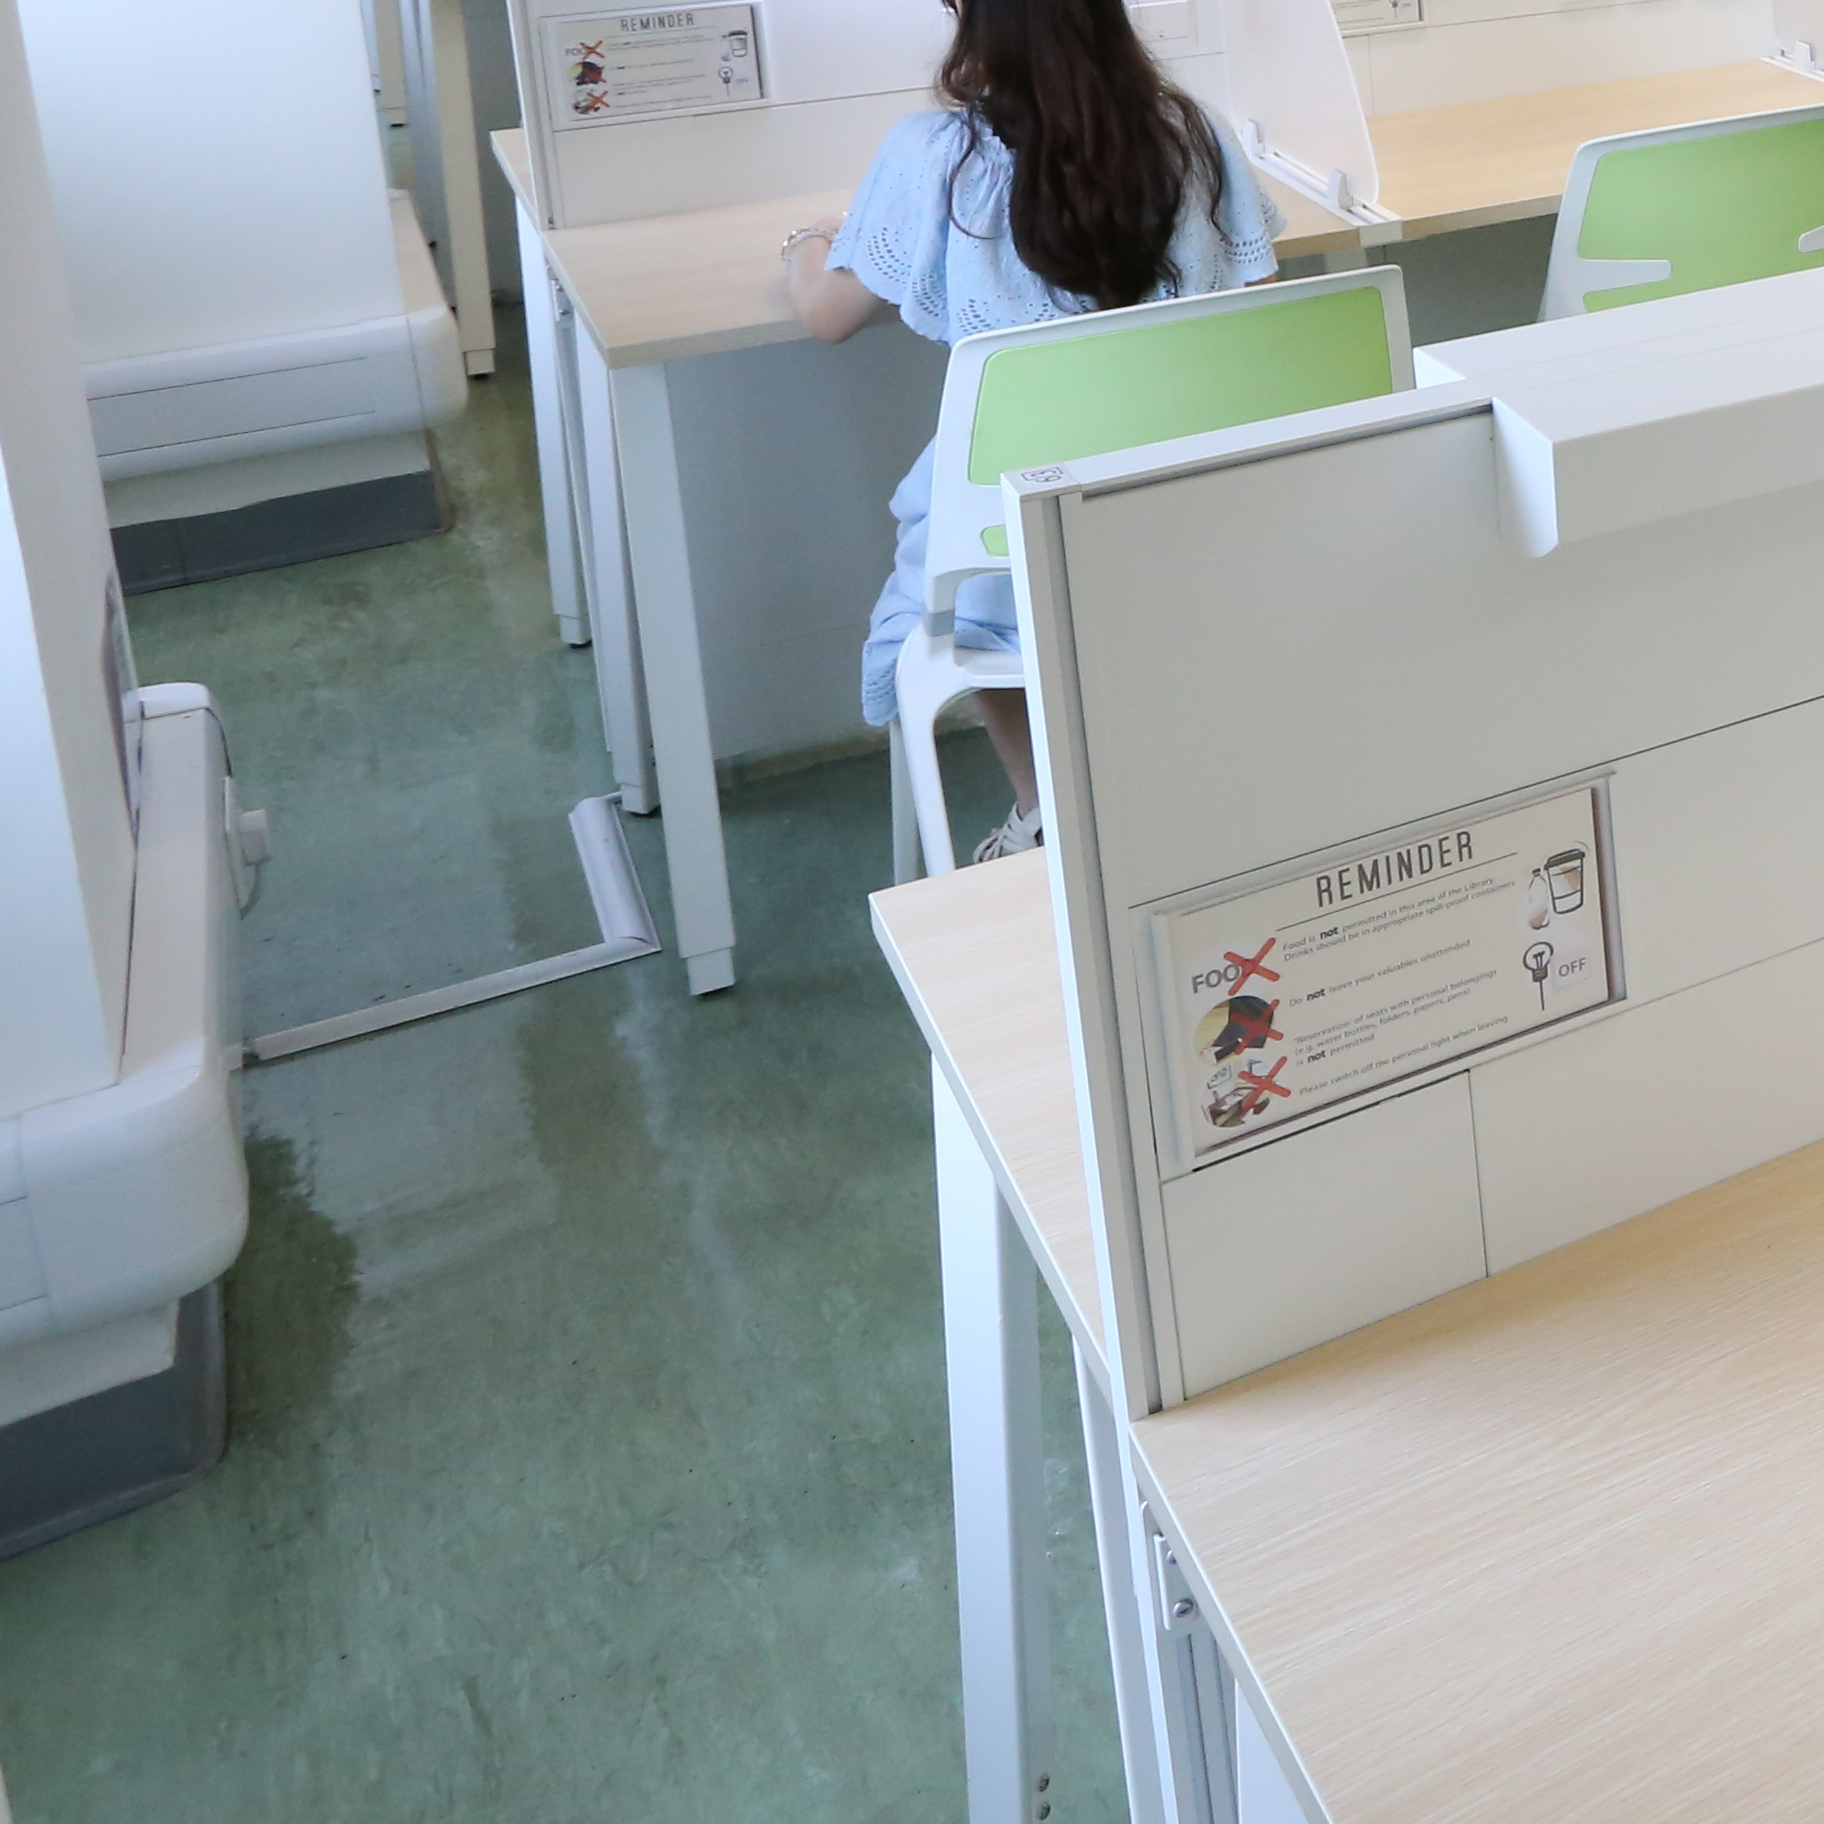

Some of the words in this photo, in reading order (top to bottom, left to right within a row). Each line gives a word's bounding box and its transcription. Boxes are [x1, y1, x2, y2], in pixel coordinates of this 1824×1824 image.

[620, 12, 694, 32] REMINDER
[1316, 831, 1473, 908] REMINDER
[1283, 936, 1306, 951] Food
[1308, 935, 1316, 943] is
[1319, 926, 1339, 940] not
[1342, 911, 1387, 933] permitted
[1389, 906, 1398, 917] in
[1399, 902, 1416, 913] this
[1417, 897, 1436, 908] area
[1438, 890, 1447, 901] of
[1448, 886, 1462, 897] the
[1464, 877, 1493, 892] Library
[1284, 947, 1313, 962] Drinks
[1315, 936, 1347, 952] should
[1348, 931, 1360, 941] be
[1362, 927, 1371, 936] in
[1372, 909, 1424, 933] appropriate
[1426, 894, 1470, 916] spill-proof
[1471, 880, 1515, 900] containers
[1289, 996, 1303, 1007] Do
[1306, 988, 1326, 1002] not
[1329, 980, 1353, 994] leave
[1355, 973, 1376, 986] your
[1377, 958, 1418, 977] valuables
[1420, 939, 1470, 962] unattended
[1354, 1014, 1364, 1024] of
[1366, 1007, 1388, 1021] seats
[1390, 998, 1410, 1012] with
[1411, 984, 1449, 1006] personal
[1450, 969, 1498, 989] belongings
[1558, 957, 1587, 978] OFF
[1296, 1059, 1304, 1067] is
[1307, 1050, 1327, 1064] not
[1329, 1033, 1375, 1056] permitted
[1317, 1034, 1343, 1048] water
[1447, 988, 1471, 1004] pens)
[1299, 1081, 1329, 1096] Please
[1330, 1069, 1359, 1085] switch
[1360, 1062, 1374, 1074] off
[1375, 1057, 1391, 1068] the
[1392, 1044, 1429, 1066] personal
[1430, 1035, 1451, 1050] light
[1452, 1026, 1477, 1041] when
[1477, 1015, 1509, 1033] leaving
